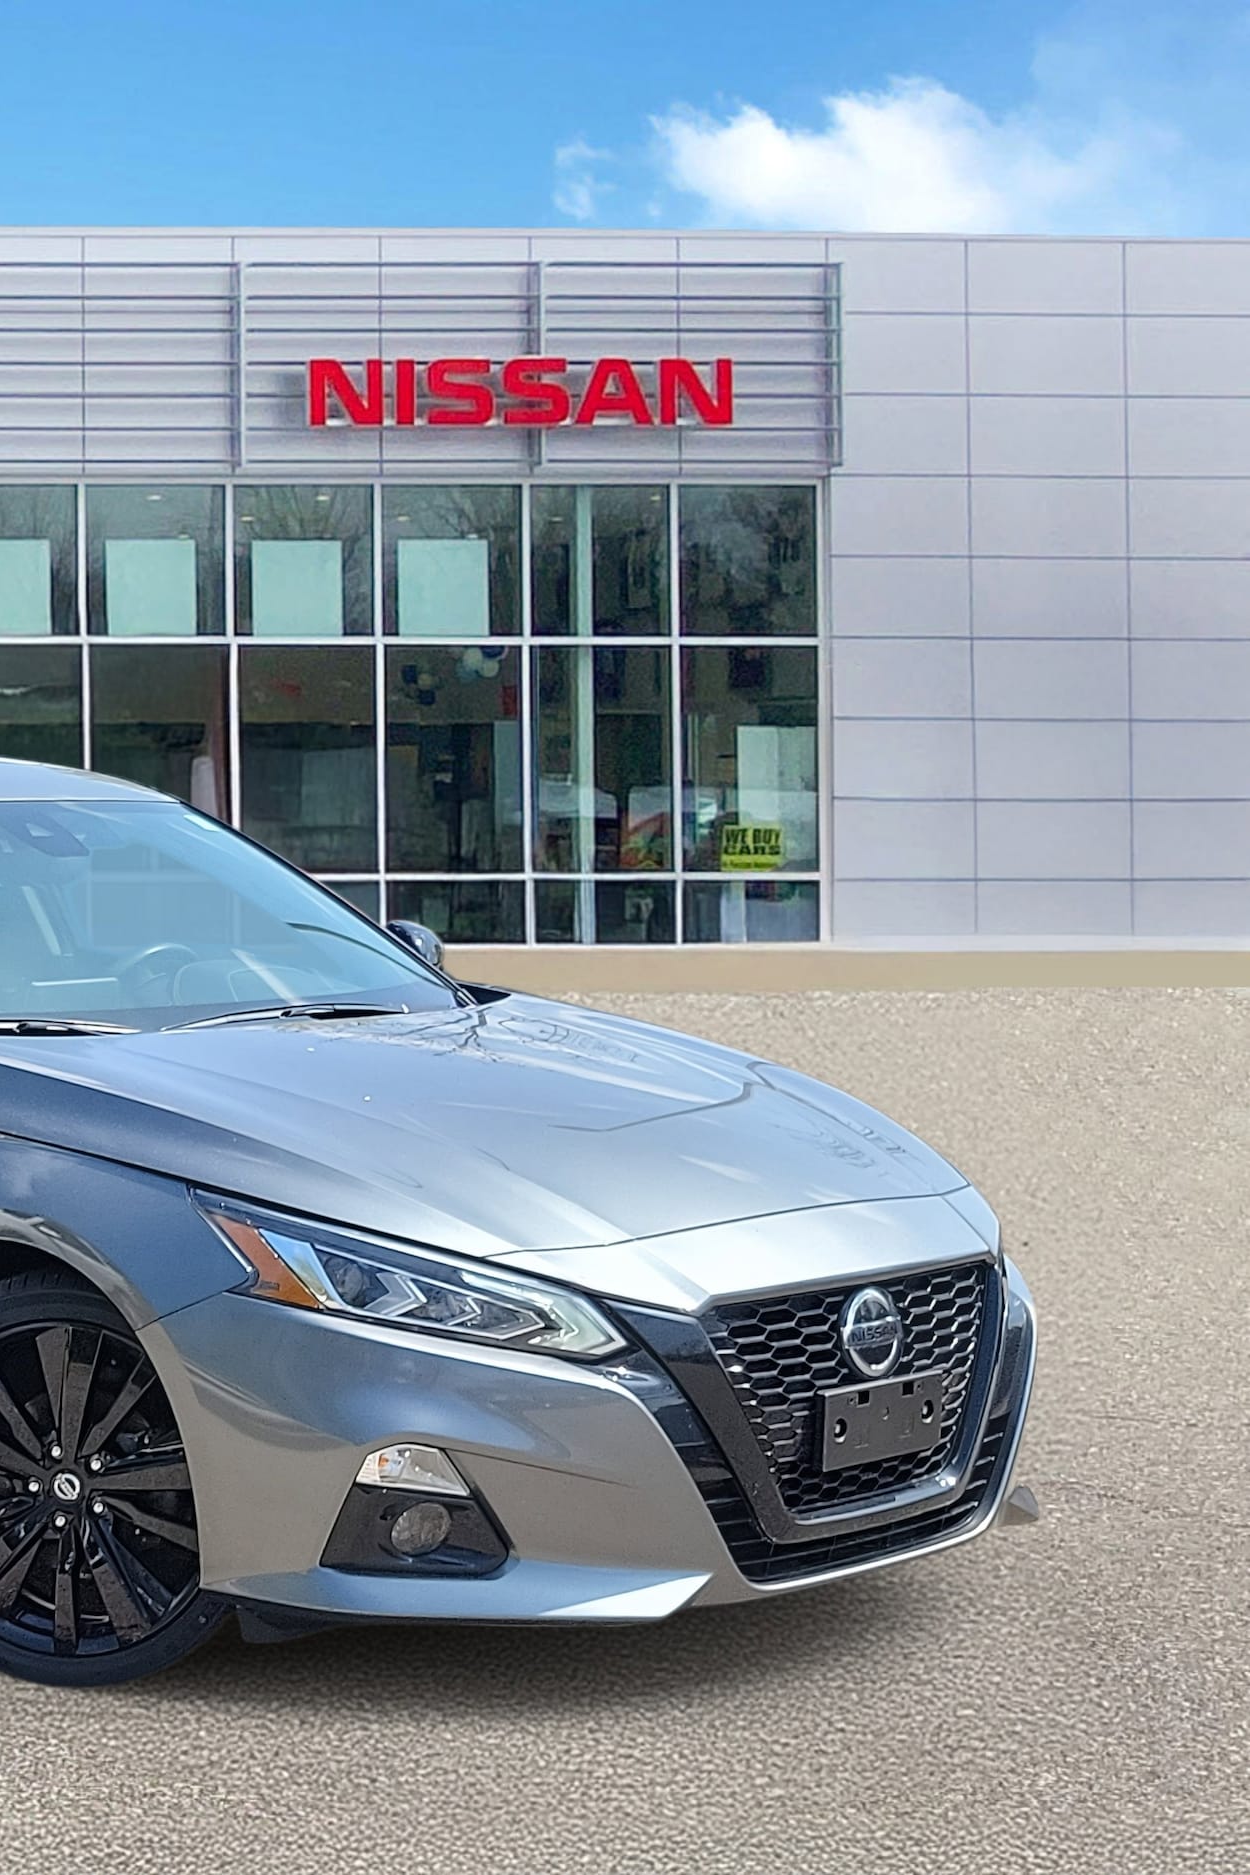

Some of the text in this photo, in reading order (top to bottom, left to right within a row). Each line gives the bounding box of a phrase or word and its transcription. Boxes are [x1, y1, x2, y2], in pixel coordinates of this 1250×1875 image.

[308, 357, 734, 427] NISSAN
[724, 828, 781, 844] WE BUY
[851, 1323, 896, 1341] NISSAN
